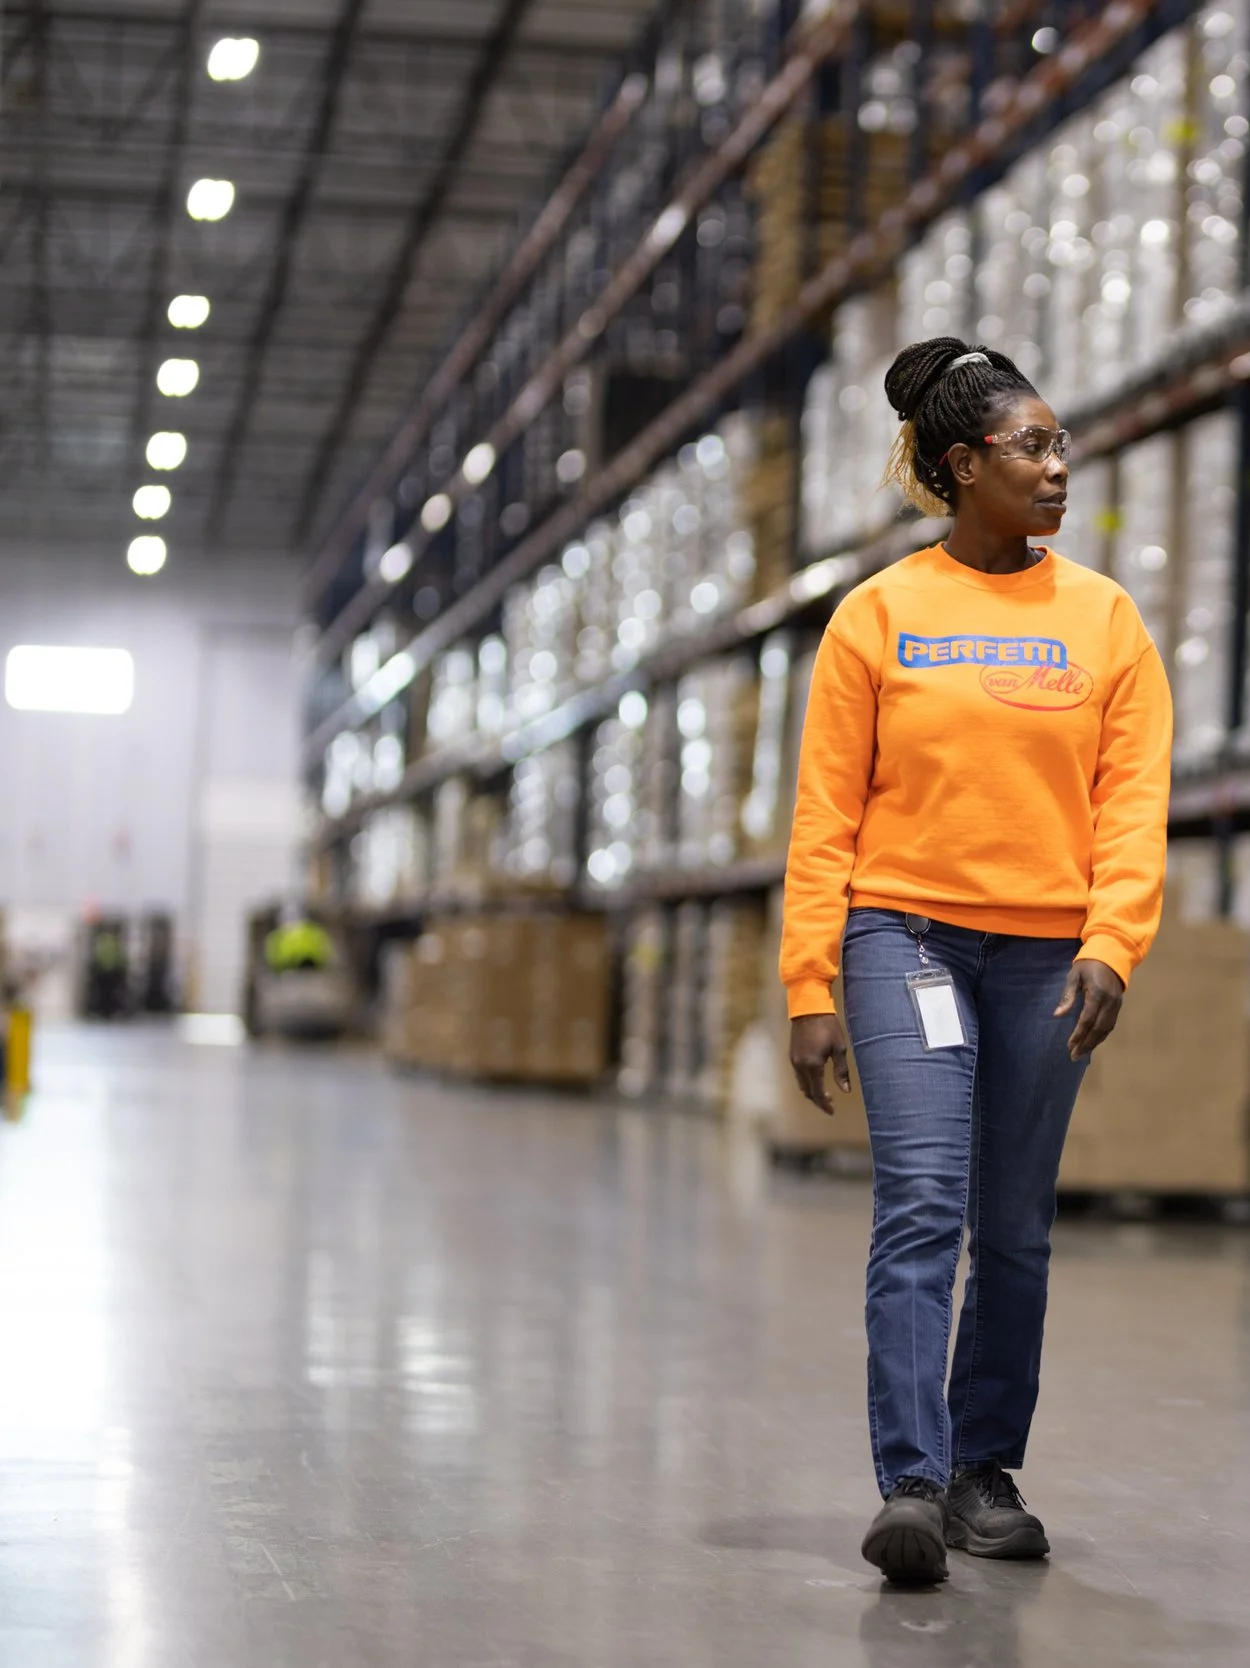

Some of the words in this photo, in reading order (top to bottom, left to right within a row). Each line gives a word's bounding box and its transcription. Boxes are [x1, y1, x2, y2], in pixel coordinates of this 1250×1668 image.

[904, 640, 1061, 663] PERFETTI
[988, 678, 1018, 688] van
[1027, 664, 1084, 694] Melle
